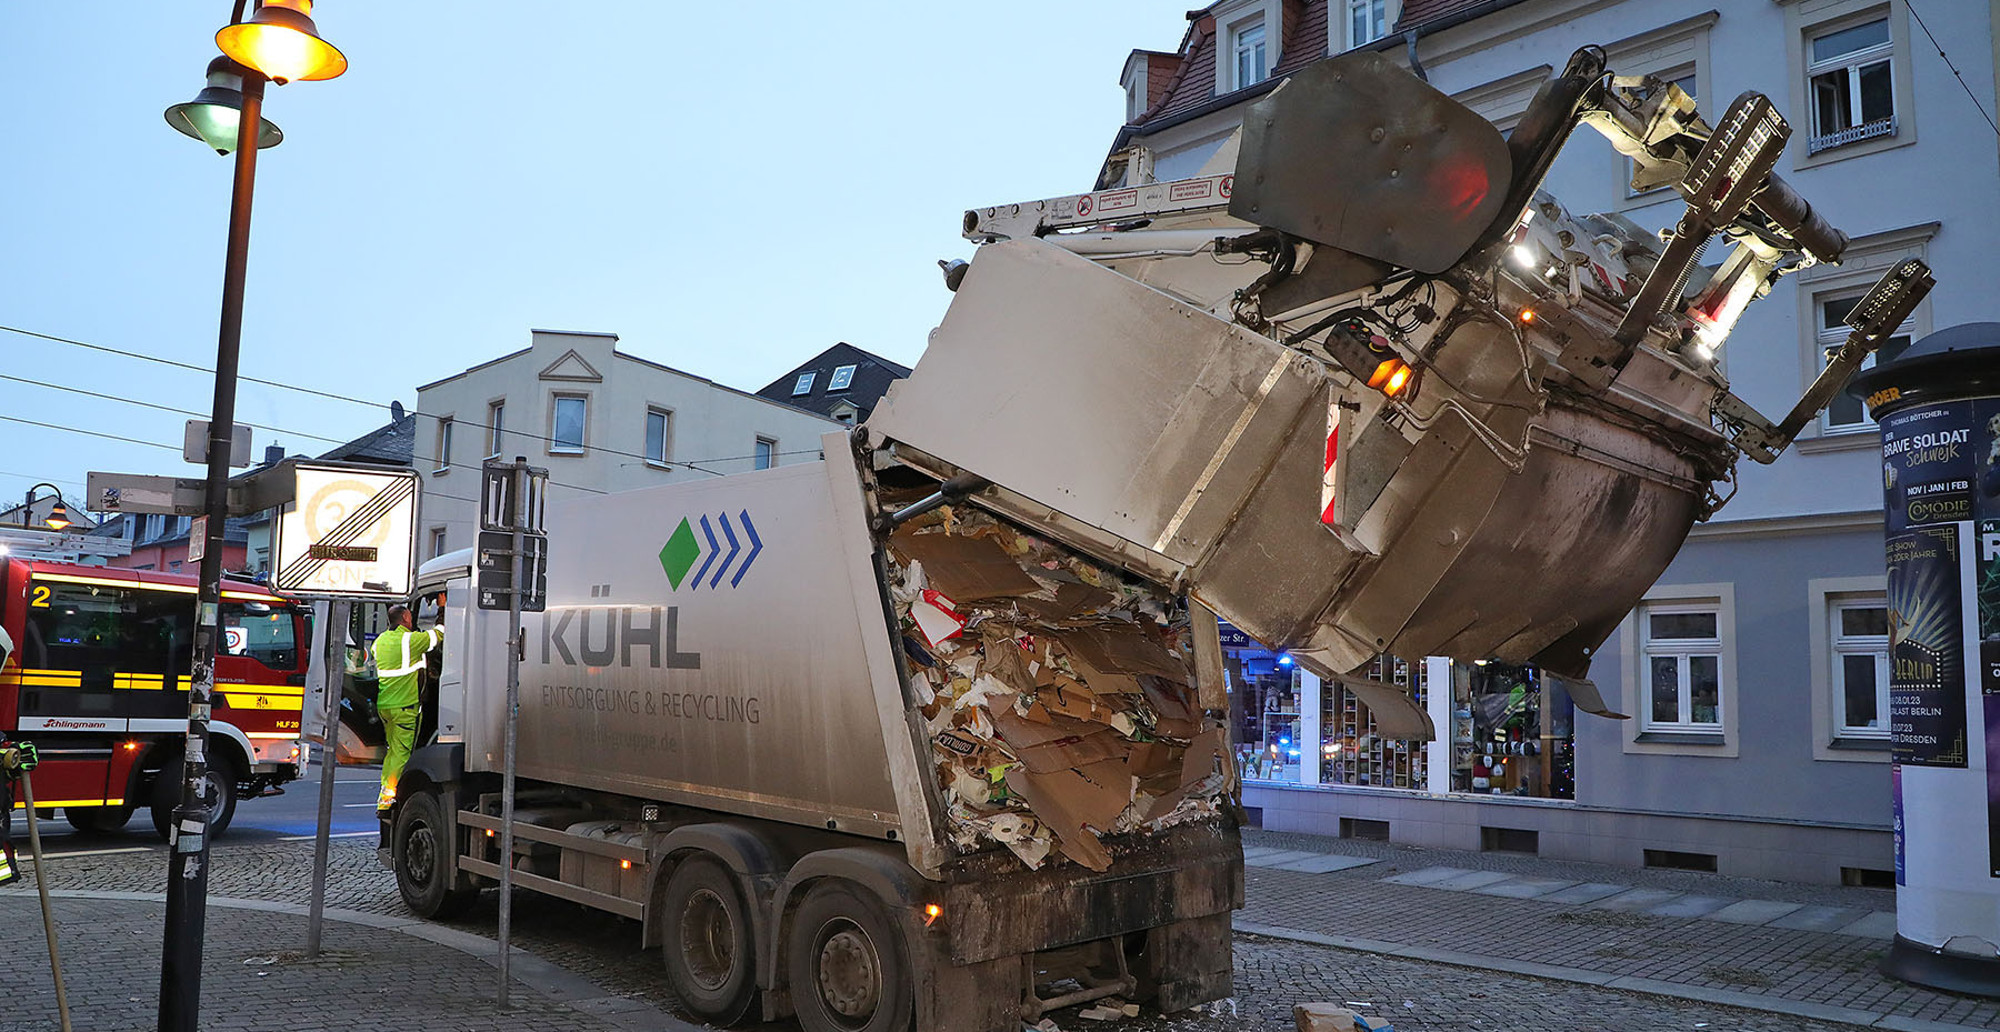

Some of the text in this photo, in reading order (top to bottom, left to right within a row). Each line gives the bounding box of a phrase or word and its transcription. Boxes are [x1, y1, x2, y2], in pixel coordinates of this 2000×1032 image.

[1910, 410, 1942, 421] BÖTTCHER
[1885, 431, 1894, 442] DER
[1884, 429, 1970, 458] BRAVE SOLDAT
[1906, 443, 1960, 468] Schwejk
[1907, 486, 1922, 496] NOV
[1928, 483, 1944, 493] JAN
[1951, 480, 1969, 490] FEB
[1933, 511, 1970, 520] Dresden
[31, 586, 51, 608] 2
[541, 584, 701, 669] KÜHL
[1232, 633, 1246, 643] Str.
[542, 685, 760, 724] ENTSORGUNG & RECYCLING
[1910, 707, 1942, 716] BERLIN
[42, 718, 107, 729] Schlingmann
[276, 720, 300, 729] HLF 20
[1899, 733, 1937, 744] DRESDEN
